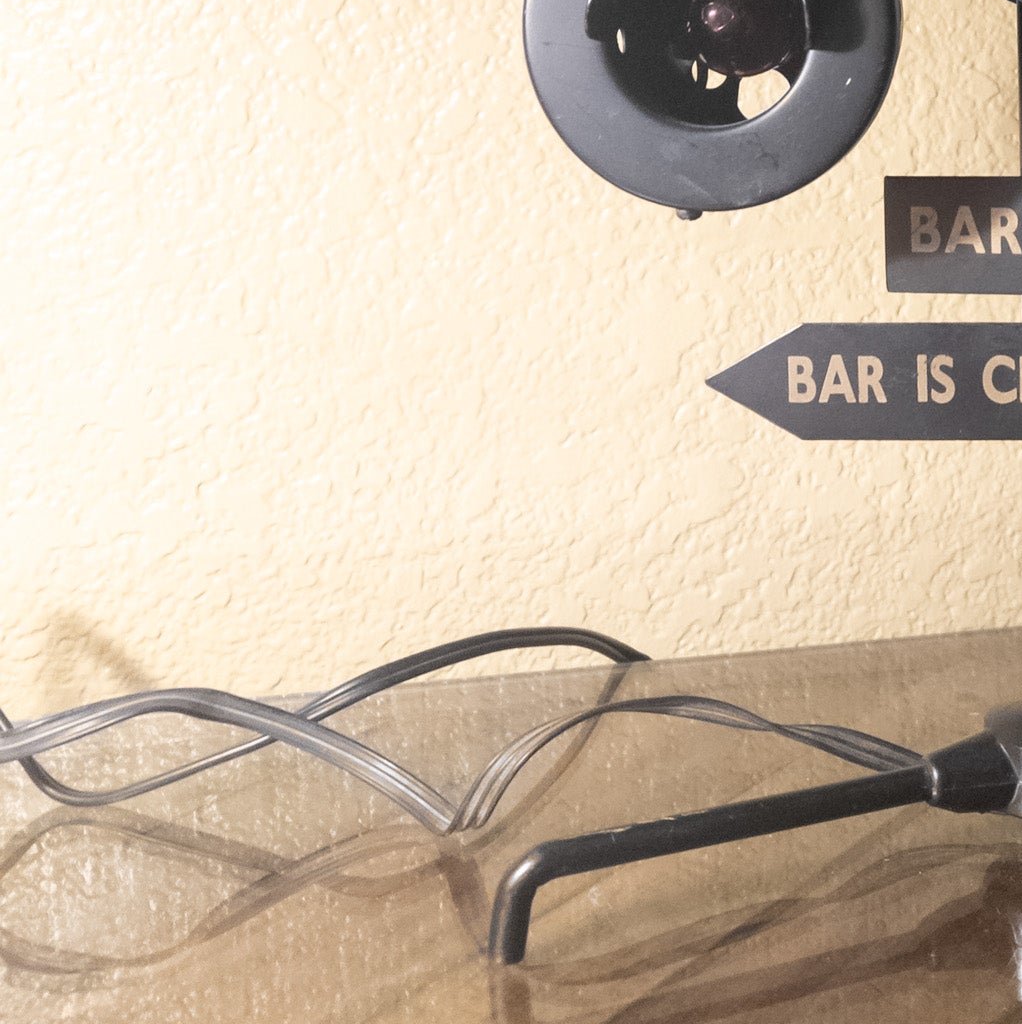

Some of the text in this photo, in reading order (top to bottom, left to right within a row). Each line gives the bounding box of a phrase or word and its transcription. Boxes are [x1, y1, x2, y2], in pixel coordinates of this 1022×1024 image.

[910, 205, 1022, 256] BAR
[787, 354, 887, 405] BAR
[917, 353, 955, 405] IS
